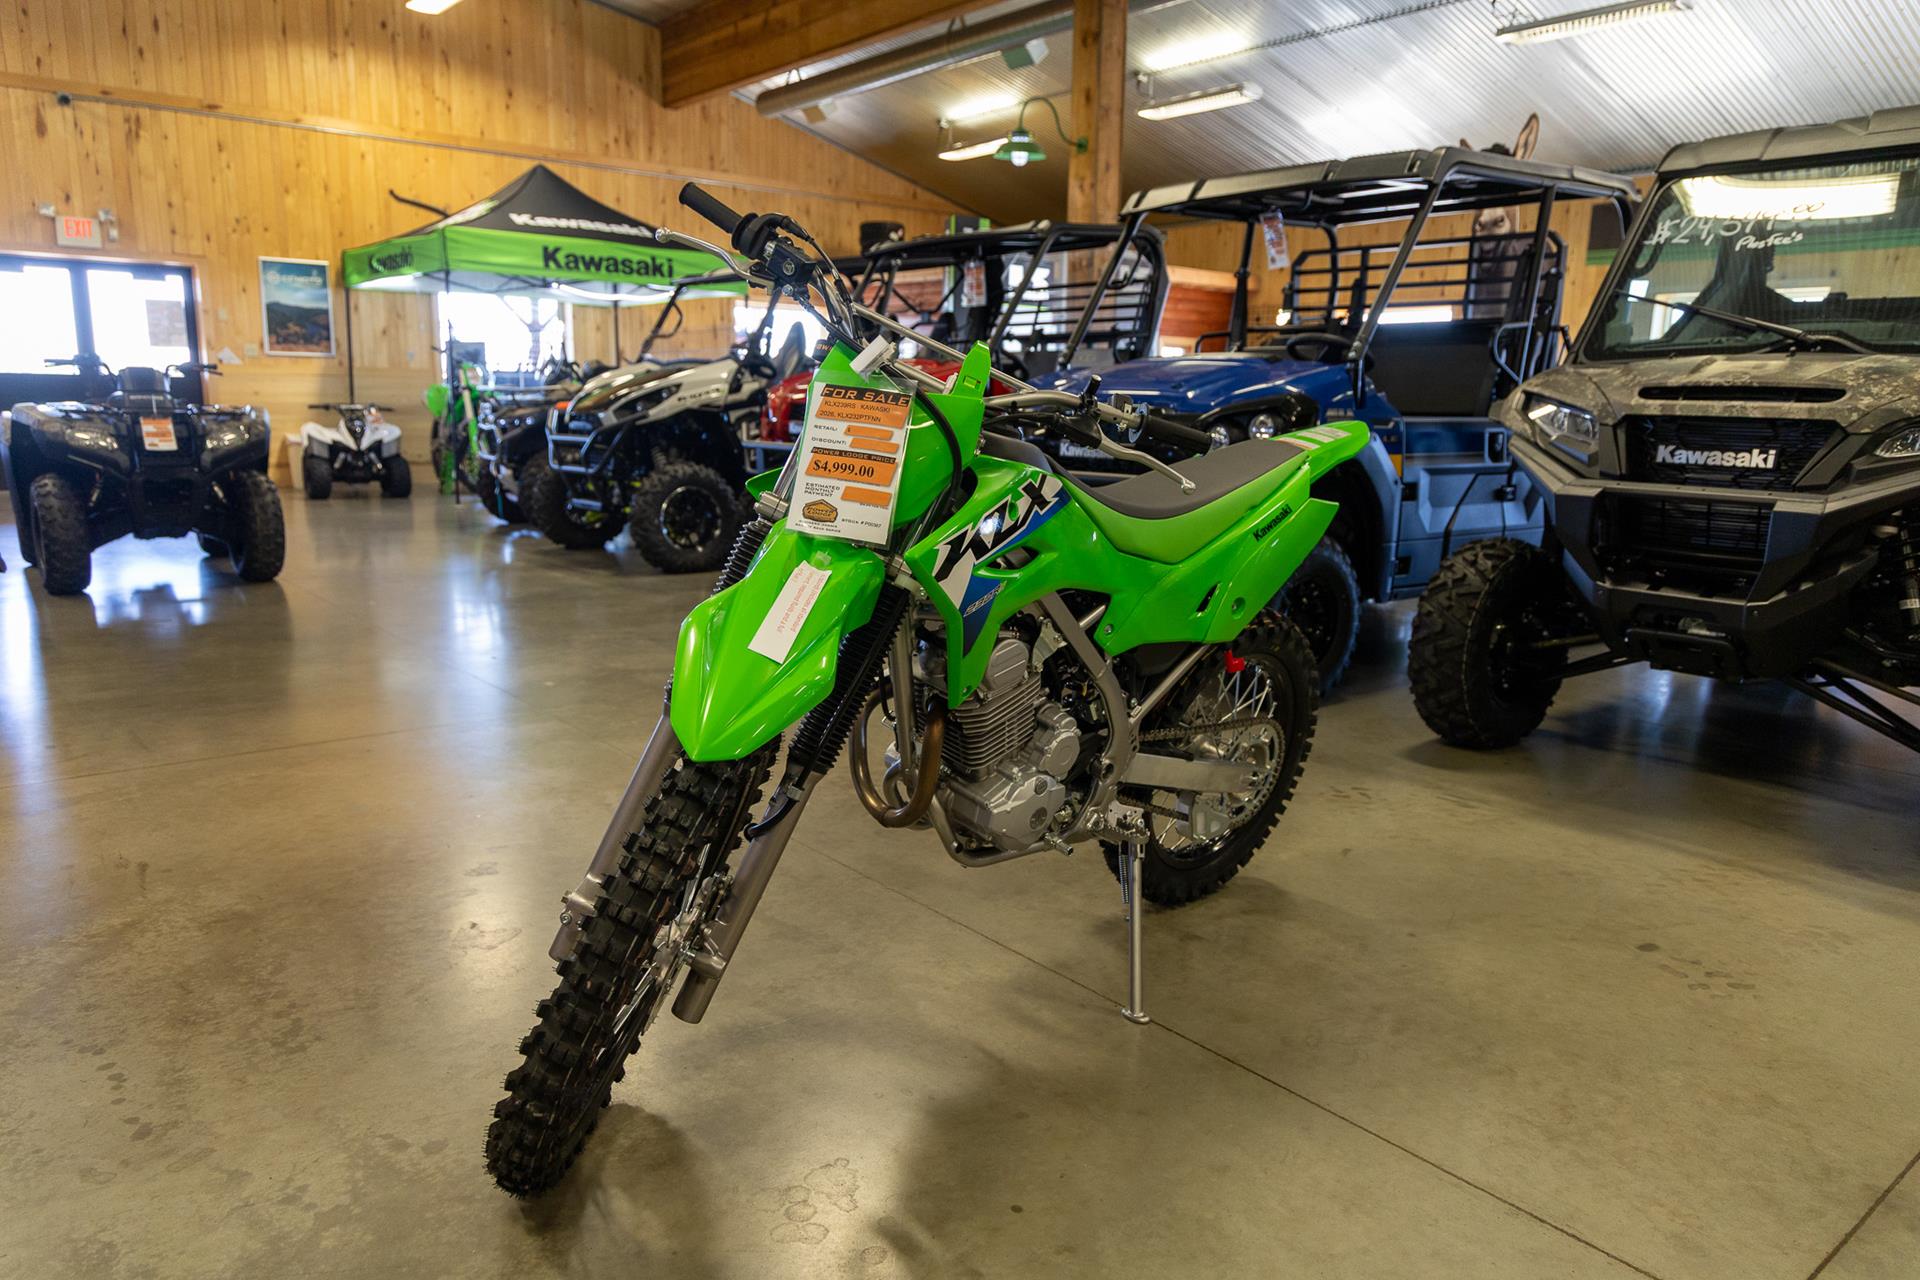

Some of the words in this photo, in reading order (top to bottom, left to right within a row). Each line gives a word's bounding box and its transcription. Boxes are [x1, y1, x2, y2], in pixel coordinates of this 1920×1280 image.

[63, 216, 93, 240] EXIT
[509, 213, 654, 239] Kawasaki
[542, 246, 674, 279] Kawasaki
[822, 387, 857, 400] FOR
[863, 392, 910, 407] SALE
[812, 448, 841, 456] POWER
[871, 455, 895, 464] PRICE
[1656, 445, 1776, 469] Kawasaki
[813, 459, 874, 478] $4,999.00
[1252, 504, 1293, 542] Kawasaki
